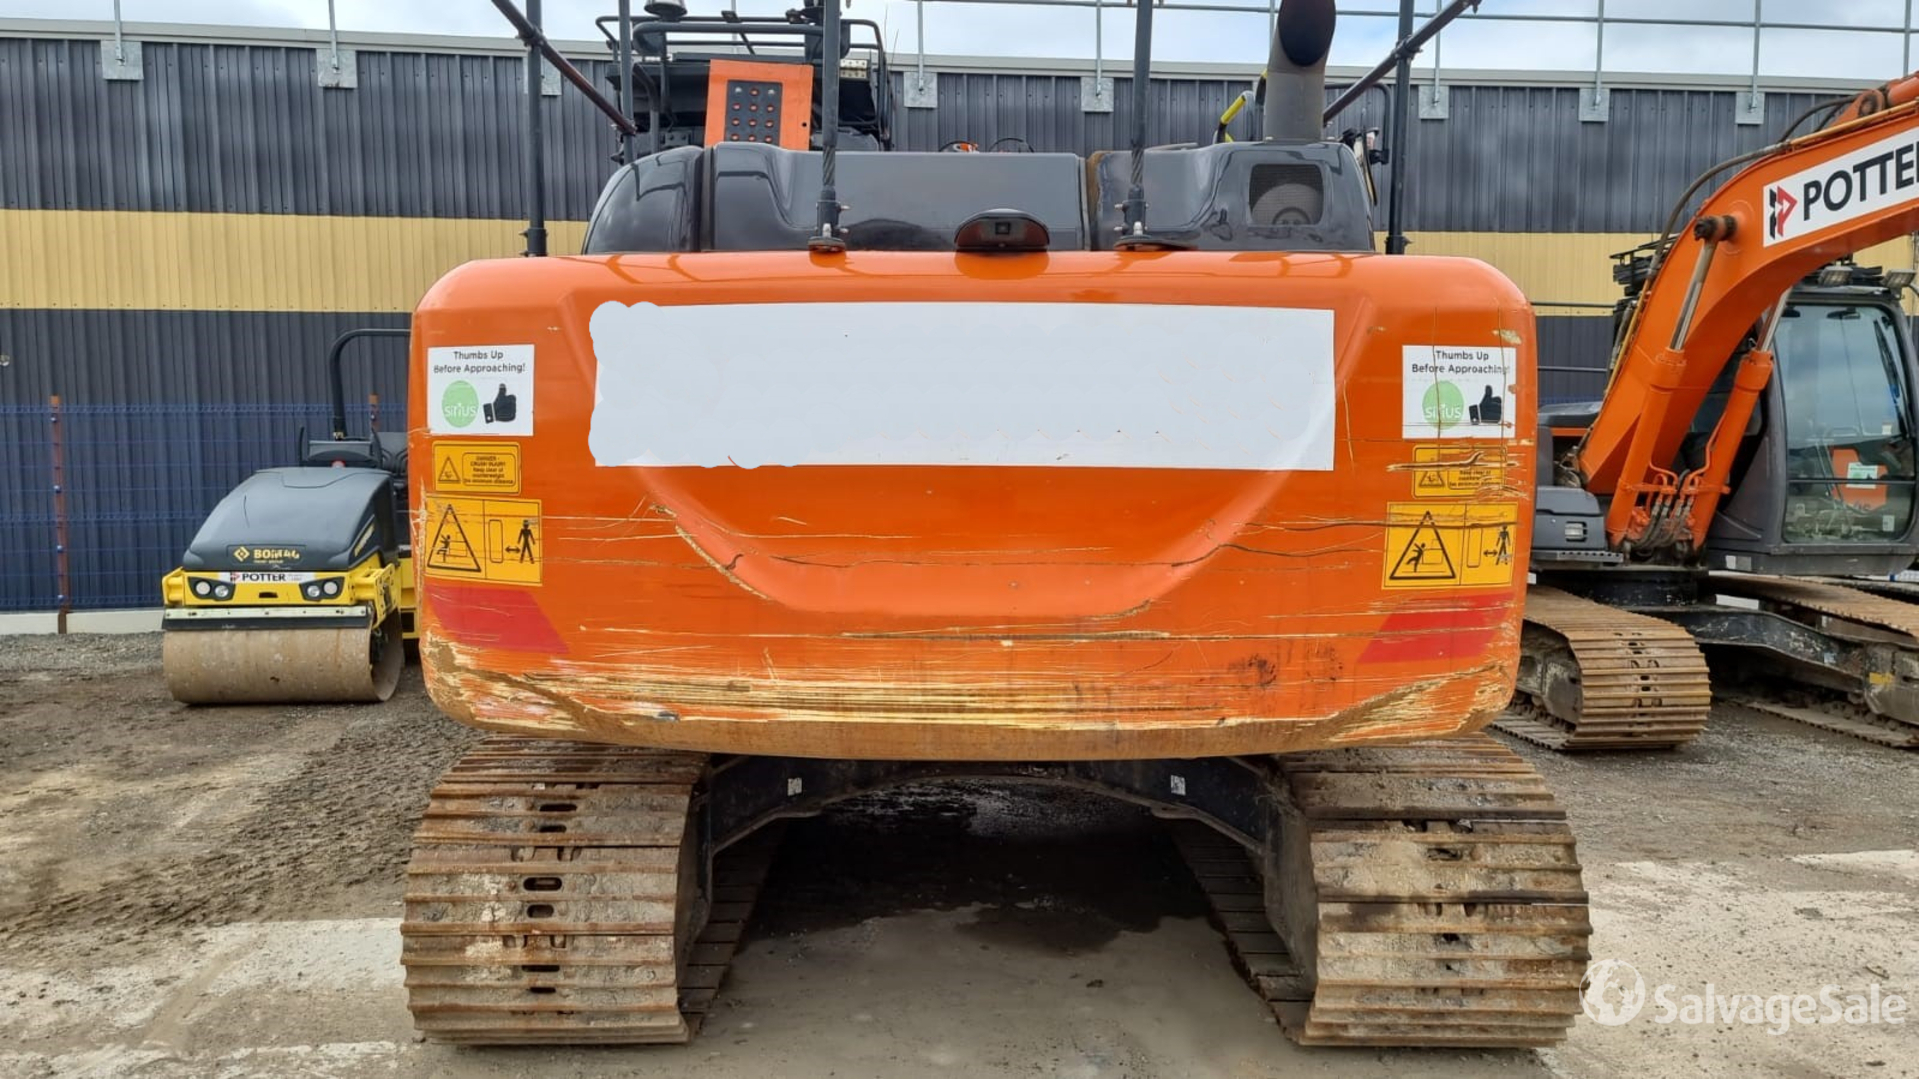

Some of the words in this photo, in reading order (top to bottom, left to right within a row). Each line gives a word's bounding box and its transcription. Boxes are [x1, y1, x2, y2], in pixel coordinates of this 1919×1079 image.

[1804, 141, 1919, 221] POTTE
[453, 350, 488, 360] Thumbs
[491, 350, 504, 360] Up
[1436, 350, 1474, 360] Thumbs
[1476, 351, 1489, 361] Up
[434, 364, 461, 374] Before
[464, 362, 526, 374] Approaching!
[1412, 363, 1445, 374] Before
[1425, 403, 1461, 419] siius
[242, 573, 286, 582] POTTER
